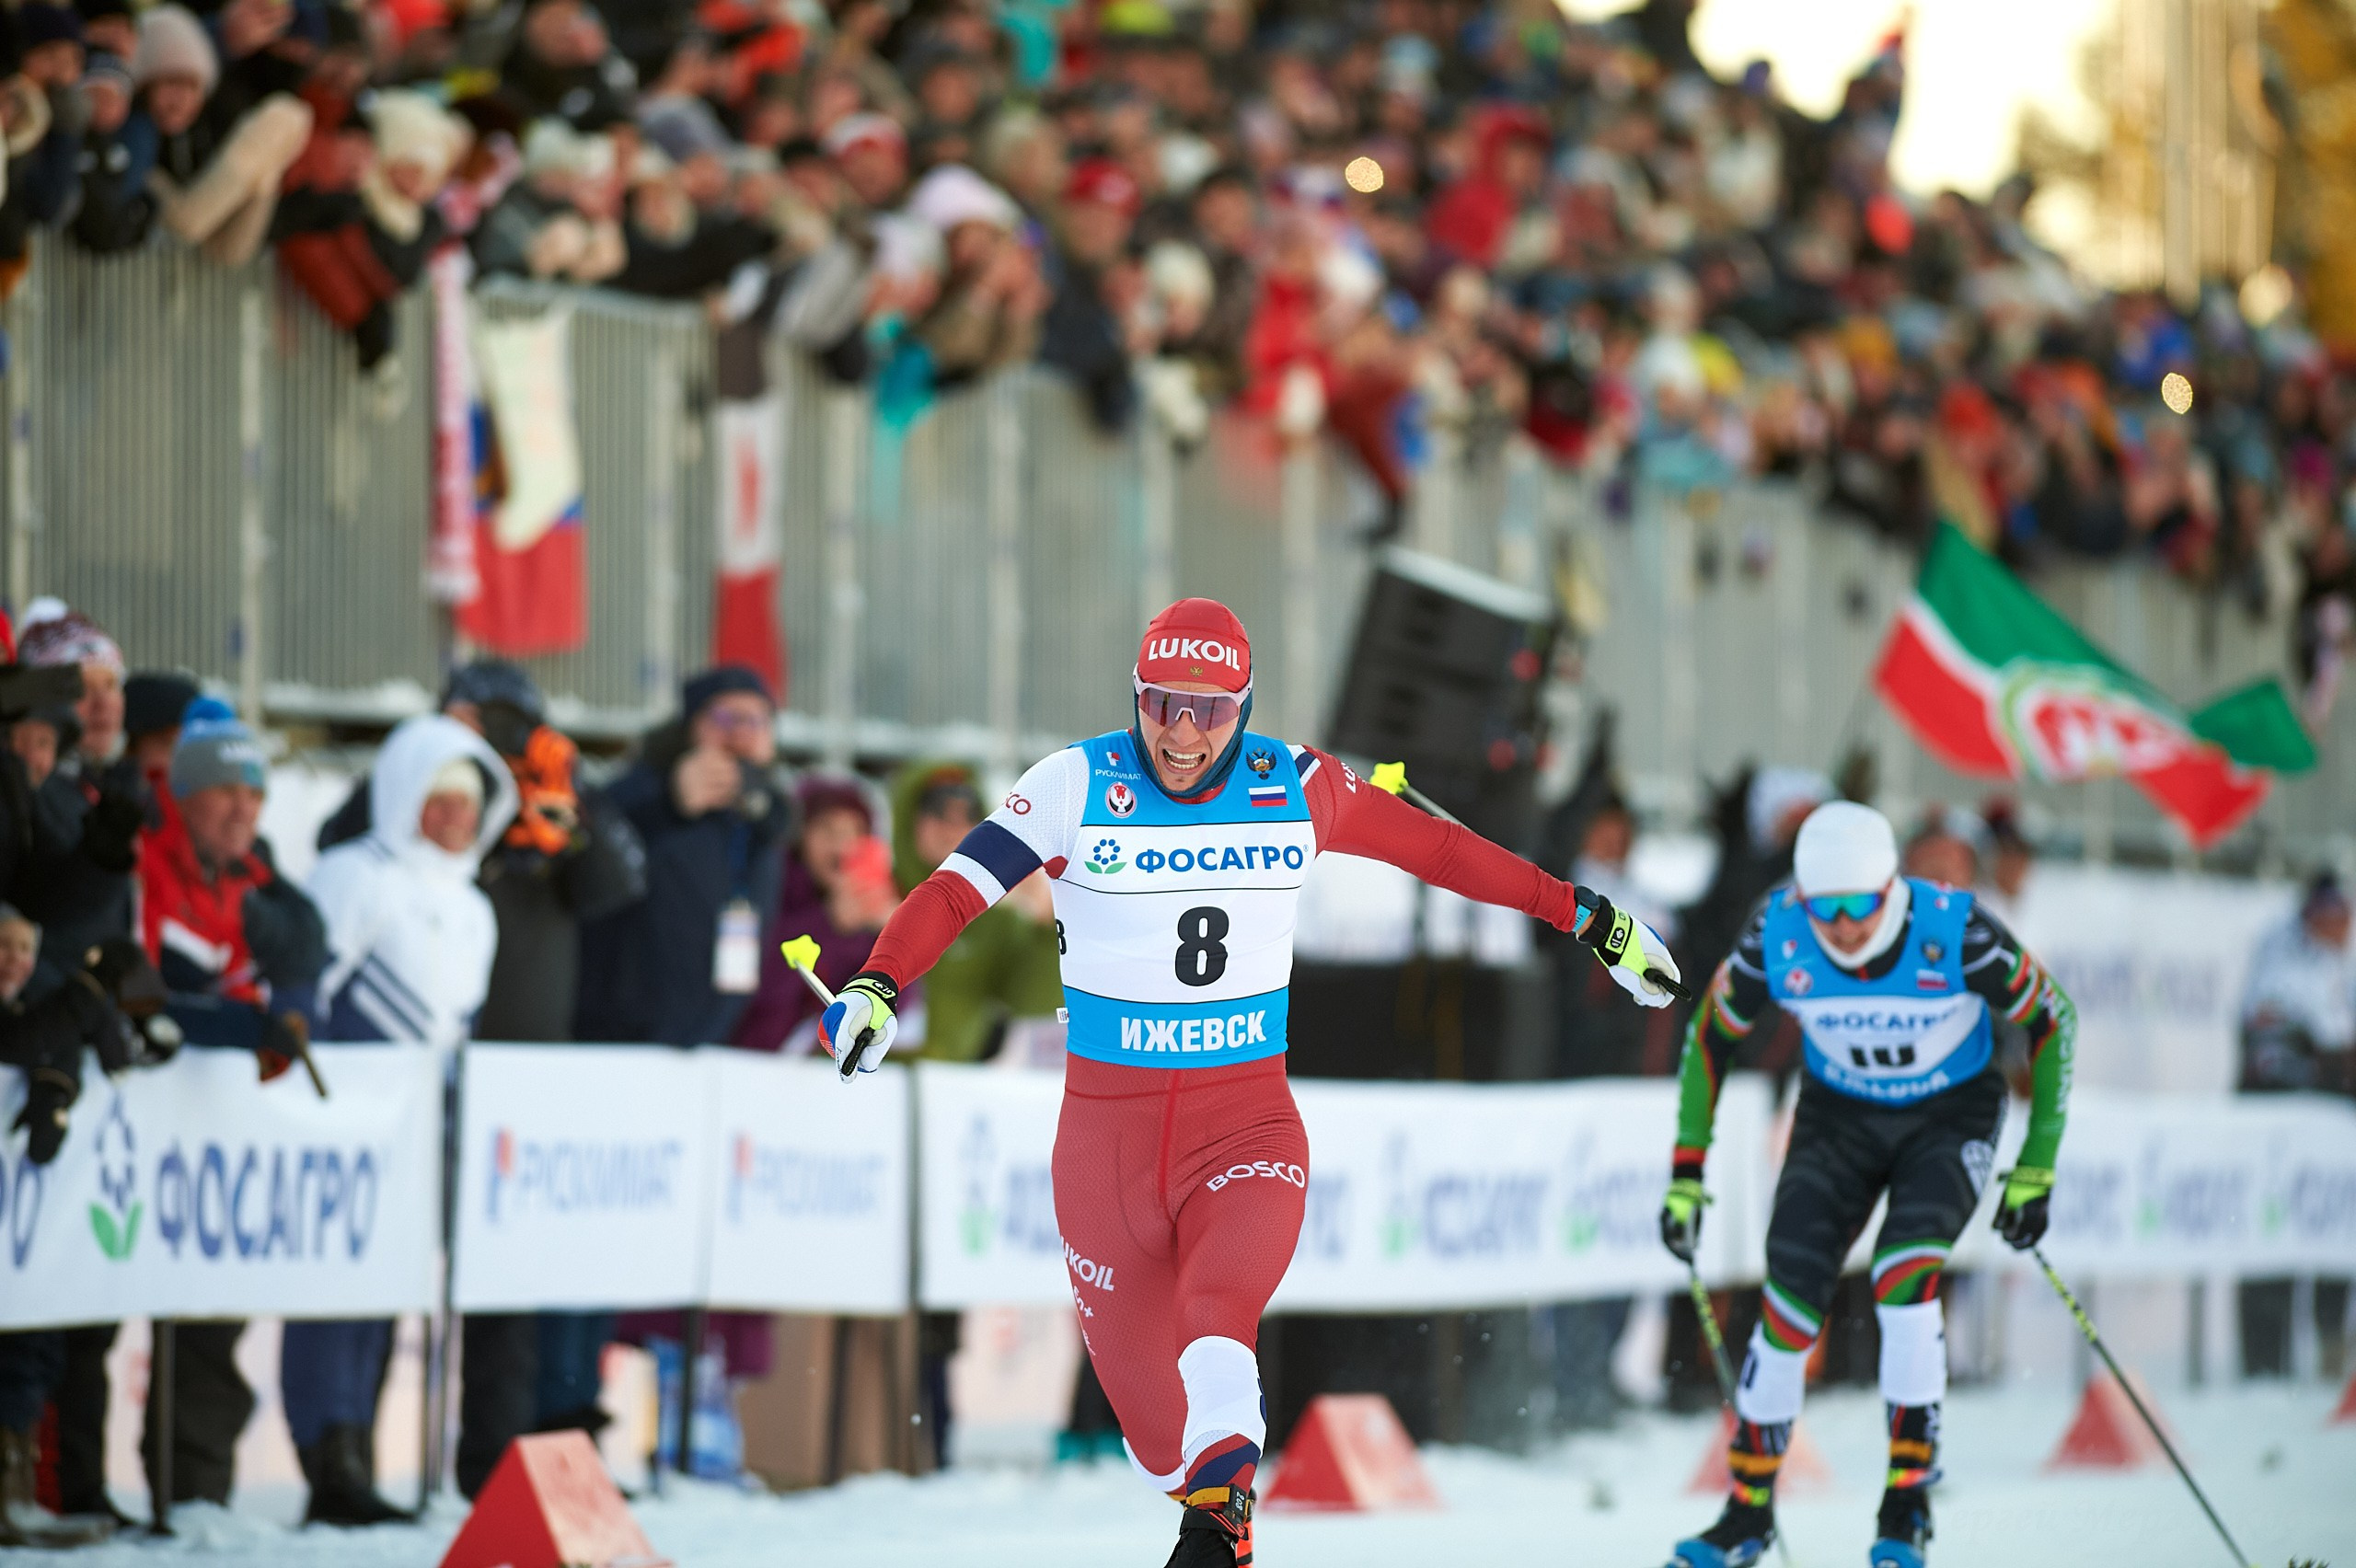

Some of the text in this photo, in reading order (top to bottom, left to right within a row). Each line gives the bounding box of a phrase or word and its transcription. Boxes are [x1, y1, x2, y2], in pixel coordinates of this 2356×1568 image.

[1148, 638, 1241, 671] LUKOIL
[1135, 846, 1304, 873] ФОСАГРО
[1174, 905, 1230, 986] 8
[1121, 1009, 1266, 1053] ИЖЕВСК
[1207, 1160, 1305, 1192] BOSCO
[156, 1137, 377, 1261] ФОСАГРО
